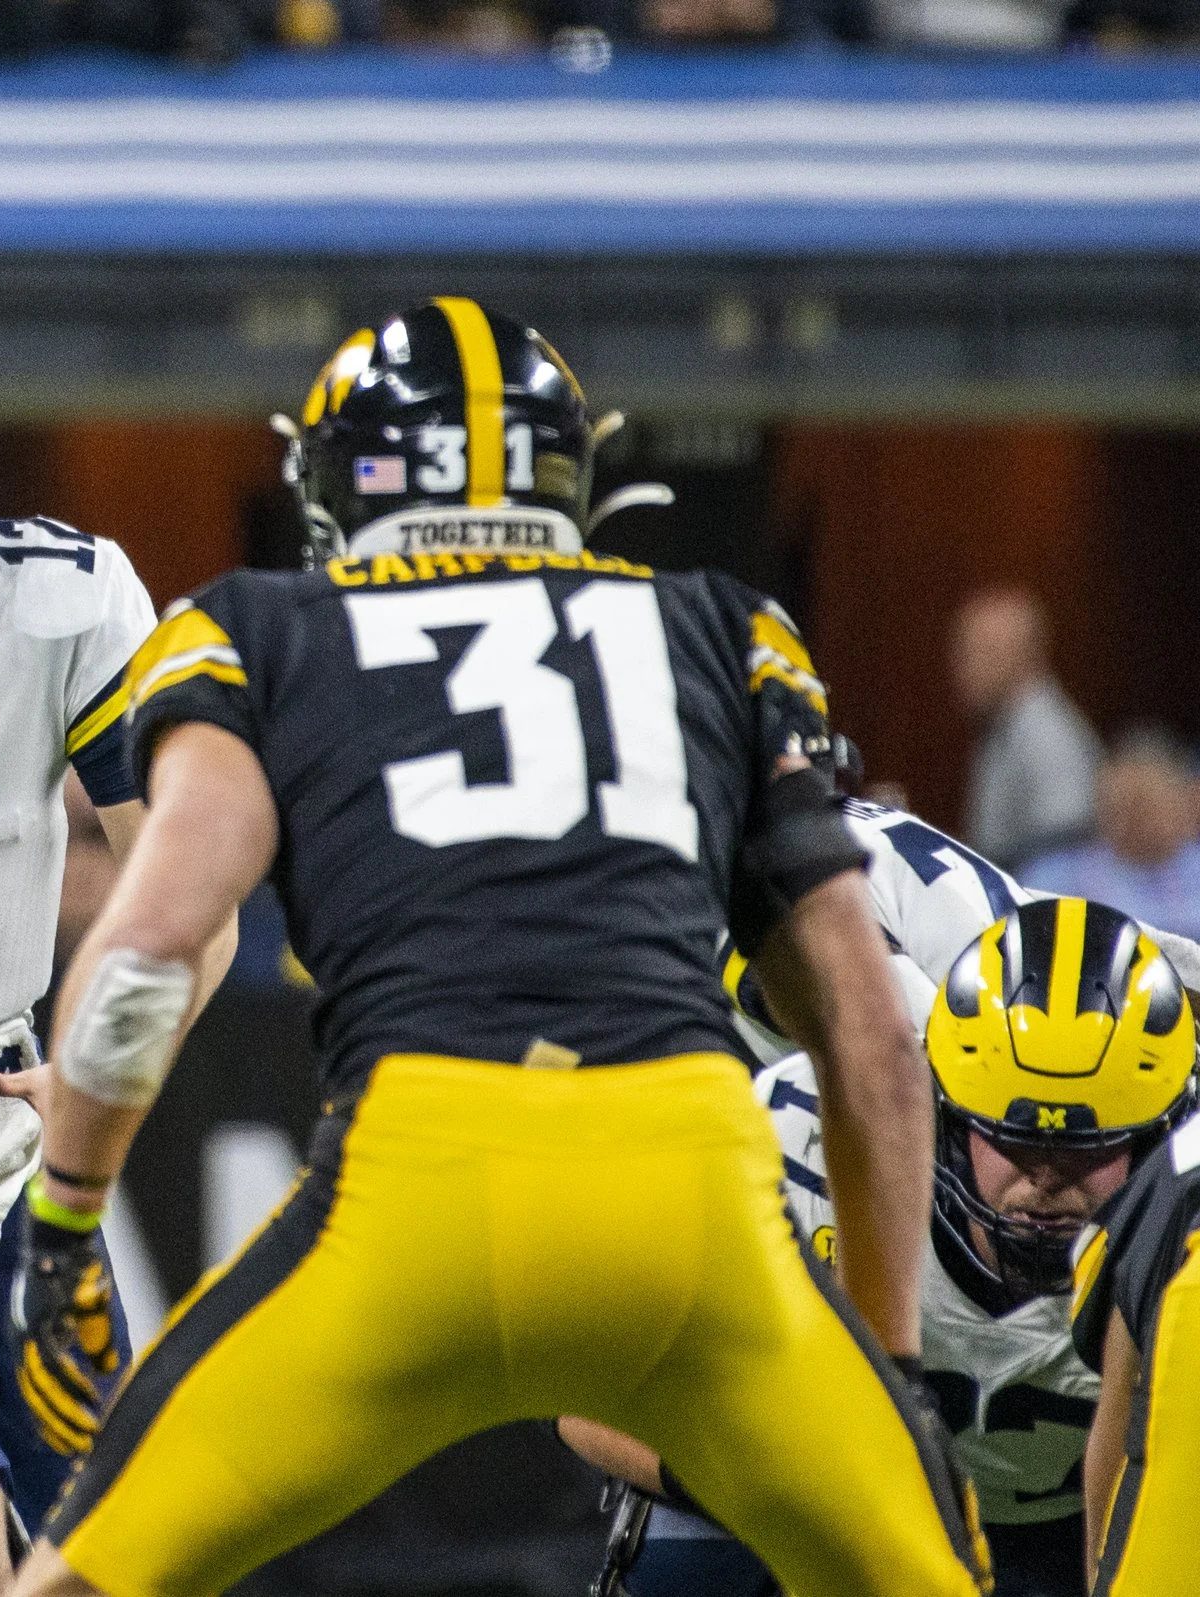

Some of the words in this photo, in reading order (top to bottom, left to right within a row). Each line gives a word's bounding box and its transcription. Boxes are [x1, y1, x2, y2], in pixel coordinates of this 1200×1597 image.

[416, 424, 535, 493] 31
[400, 520, 556, 554] TOGETHER
[342, 576, 699, 864] 31
[1037, 1106, 1066, 1129] M
